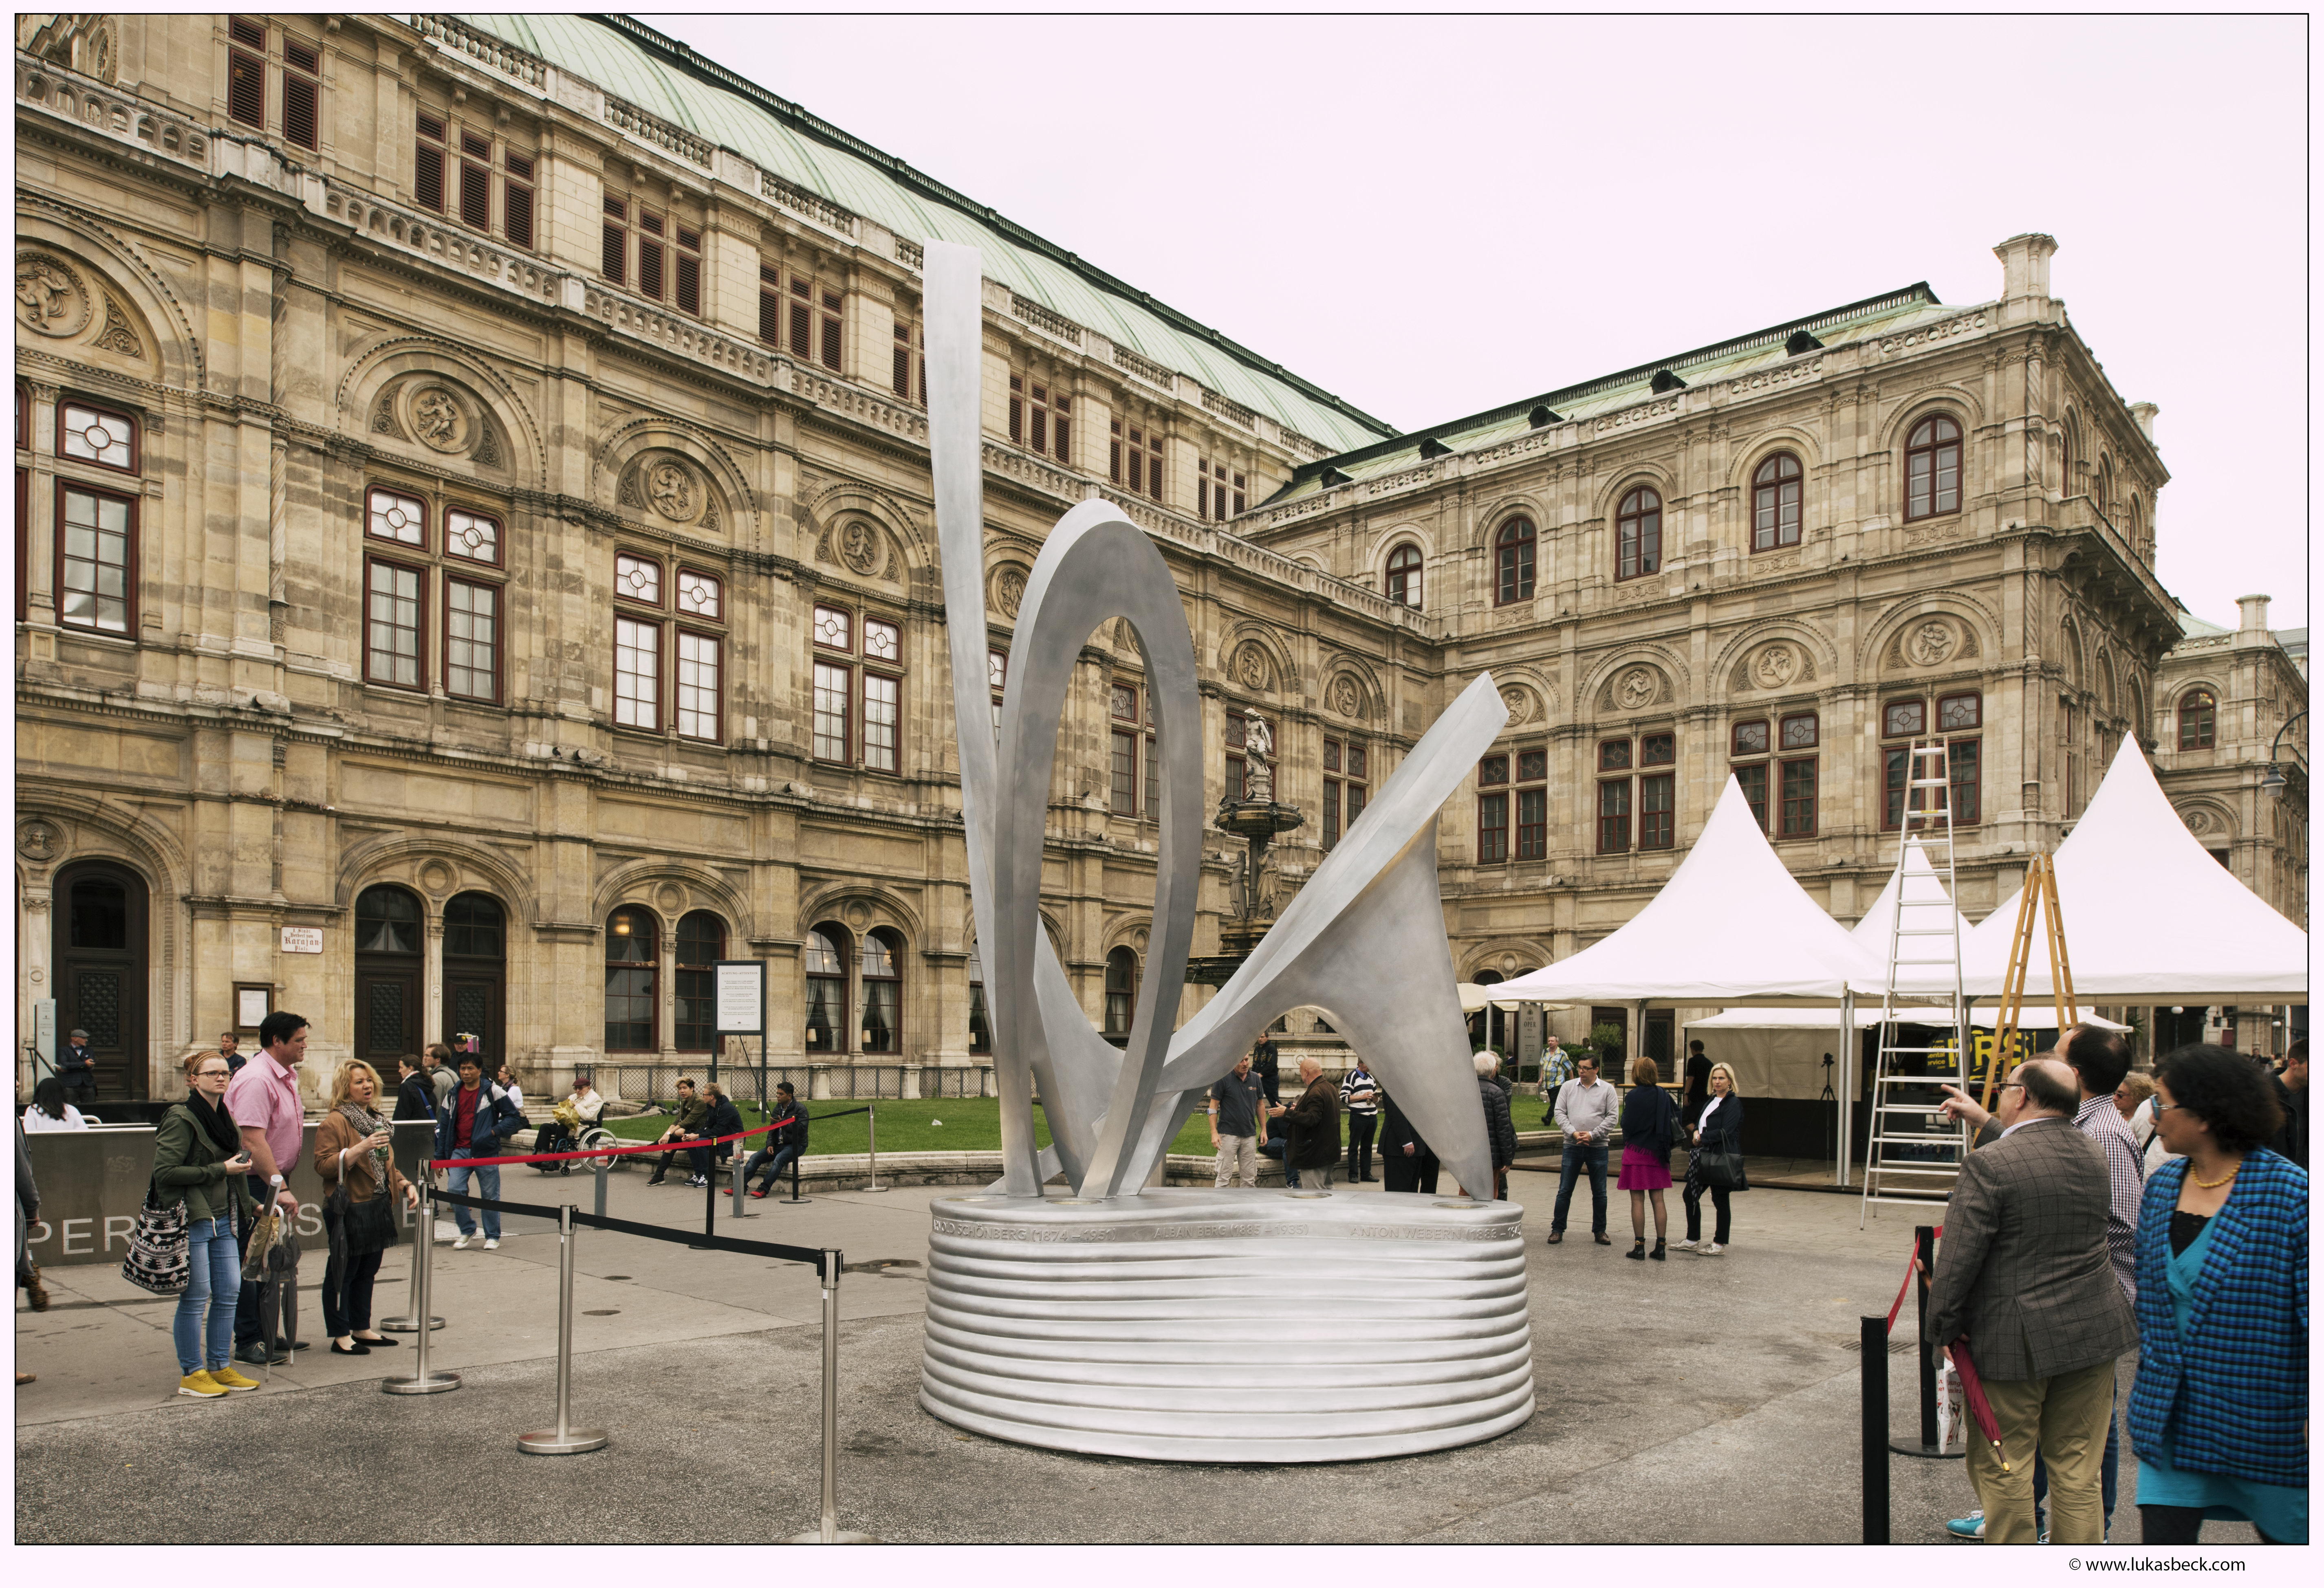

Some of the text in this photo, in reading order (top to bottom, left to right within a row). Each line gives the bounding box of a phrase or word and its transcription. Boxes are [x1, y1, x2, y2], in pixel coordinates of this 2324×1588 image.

[284, 936, 321, 947] Karajan-
[958, 1224, 1027, 1241] SCHÖNBERG
[1031, 1228, 1068, 1242] (1874
[1084, 1228, 1116, 1241] 1951)
[1154, 1226, 1193, 1239] ALBAN
[1197, 1225, 1227, 1237] BERG
[1230, 1223, 1261, 1237] (1885
[1275, 1223, 1309, 1236] 1935)
[1350, 1225, 1399, 1238] ANTON
[1403, 1227, 1461, 1240] WEBERN
[1467, 1227, 1497, 1241] (1883
